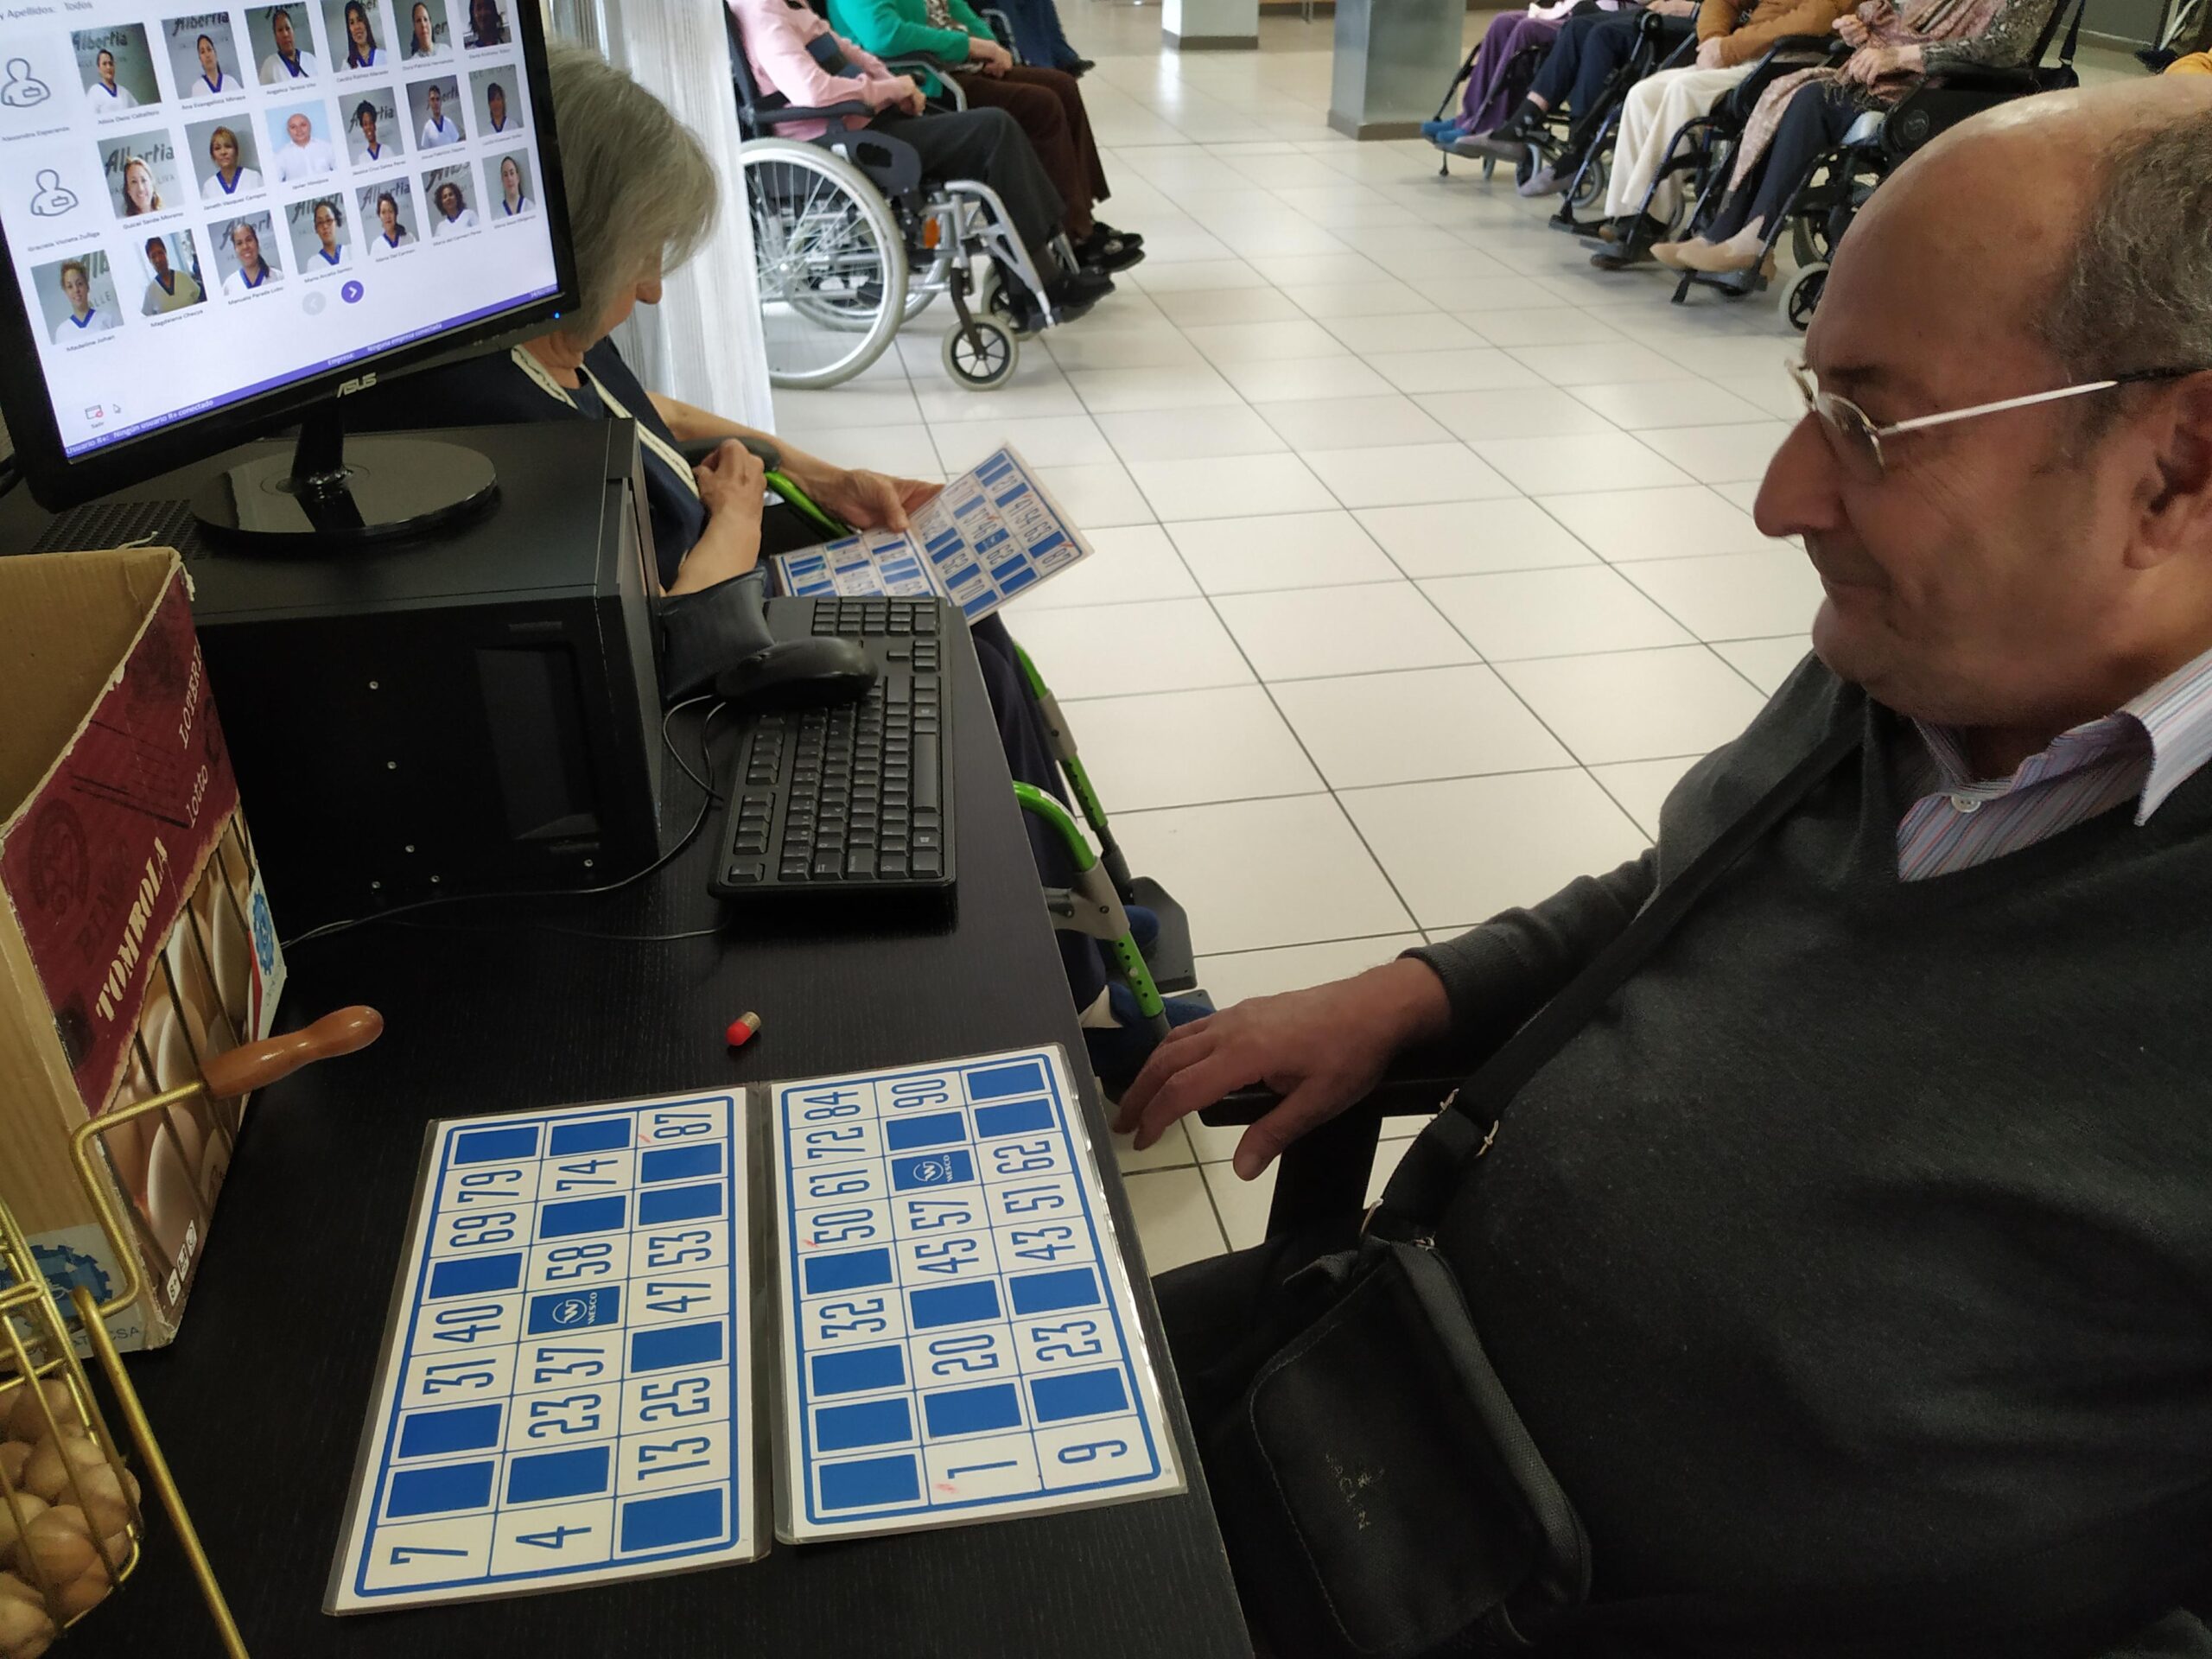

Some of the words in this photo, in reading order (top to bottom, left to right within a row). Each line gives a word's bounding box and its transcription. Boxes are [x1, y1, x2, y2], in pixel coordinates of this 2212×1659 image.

[337, 372, 377, 398] ASUS
[987, 544, 1014, 565] 62
[1024, 521, 1052, 543] 63
[1042, 548, 1071, 568] 87
[943, 553, 969, 575] 52
[957, 579, 985, 601] 70
[188, 764, 208, 829] lotto
[95, 836, 168, 1022] TOMBOLA
[804, 1091, 859, 1121] 84
[893, 1078, 949, 1108] 90
[654, 1113, 711, 1140] 87
[807, 1126, 865, 1160] 72
[993, 1140, 1055, 1175] 62
[458, 1169, 522, 1204] 79
[556, 1160, 618, 1192] 74
[810, 1169, 871, 1198] 61
[911, 1201, 971, 1231] 57
[1005, 1185, 1065, 1214] 51
[450, 1211, 516, 1247] 69
[812, 1208, 875, 1244] 50
[1011, 1226, 1075, 1261] 43
[546, 1243, 612, 1281] 58
[649, 1230, 712, 1268] 53
[915, 1237, 979, 1274] 45
[588, 1292, 597, 1325] WESCO
[646, 1282, 711, 1313] 47
[433, 1304, 503, 1343] 40
[819, 1298, 887, 1339] 32
[929, 1334, 999, 1375] 20
[1031, 1320, 1102, 1361] 23
[423, 1359, 496, 1395] 31
[535, 1348, 605, 1383] 37
[528, 1394, 601, 1438] 23
[640, 1376, 710, 1421] 25
[639, 1436, 710, 1480] 13
[948, 1460, 1018, 1479] 1
[1058, 1440, 1127, 1464] 9
[516, 1526, 592, 1548] 4
[391, 1547, 467, 1564] 7
